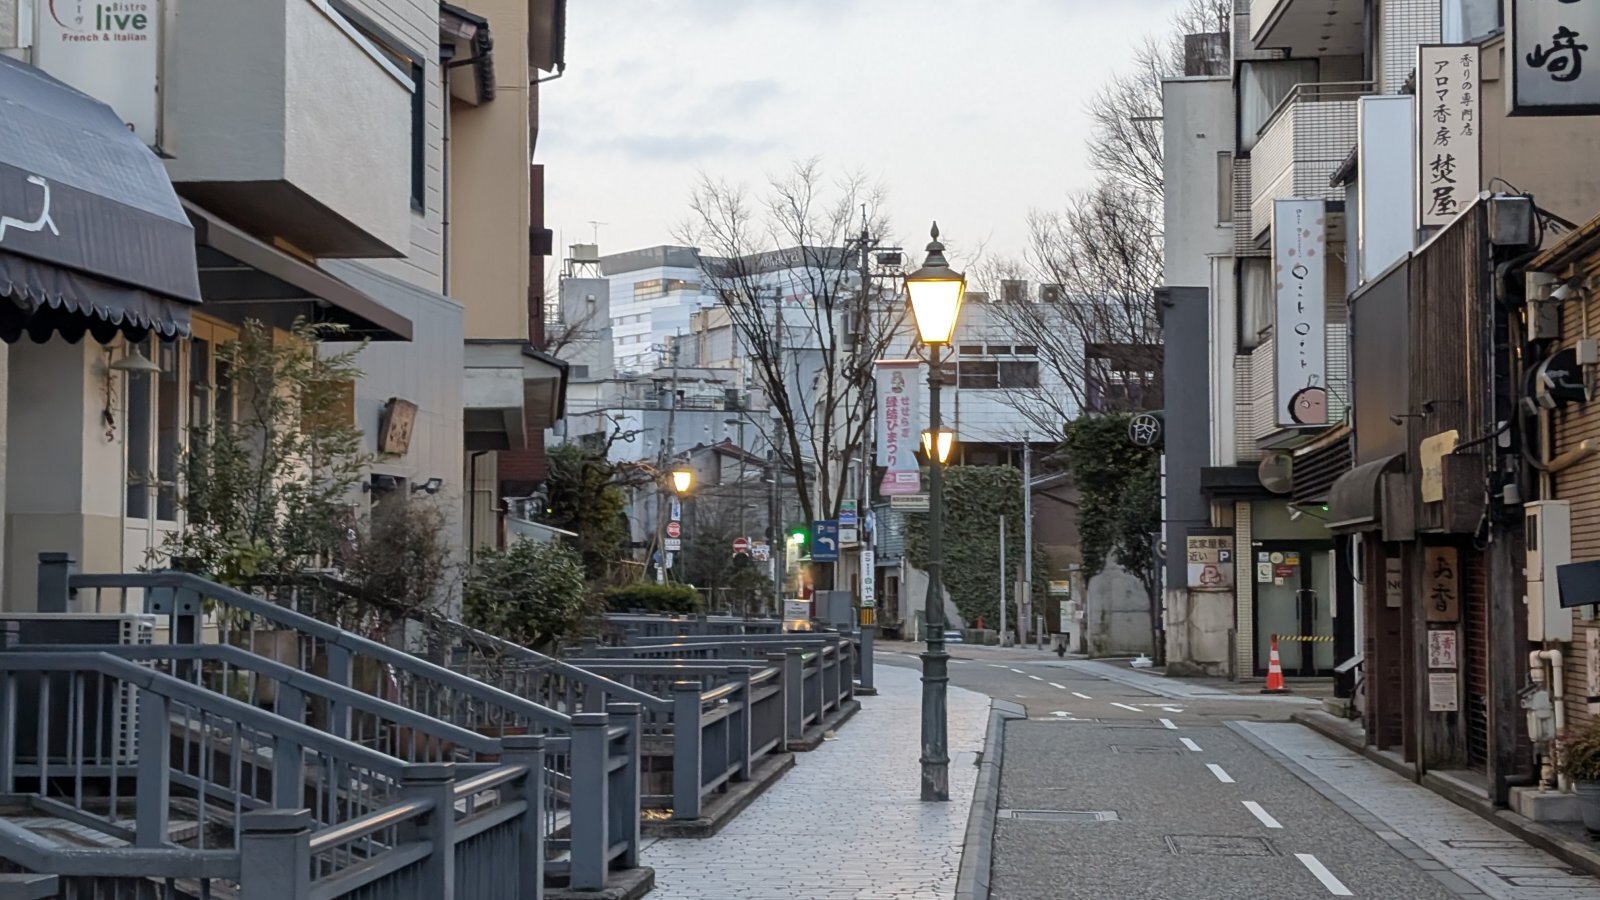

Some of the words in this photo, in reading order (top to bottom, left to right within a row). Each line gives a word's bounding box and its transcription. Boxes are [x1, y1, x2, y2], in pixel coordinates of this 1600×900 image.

[113, 2, 147, 12] Bistro
[62, 33, 98, 42] French
[103, 33, 110, 42] &
[114, 33, 147, 42] Italian
[1526, 0, 1588, 82] 崎
[1460, 53, 1474, 137] 香りの専門店
[1432, 59, 1452, 147] アロマ香房
[885, 395, 898, 466] 縁結びまつり
[817, 525, 825, 535] P
[1189, 551, 1208, 562] 近い
[1219, 550, 1229, 562] P
